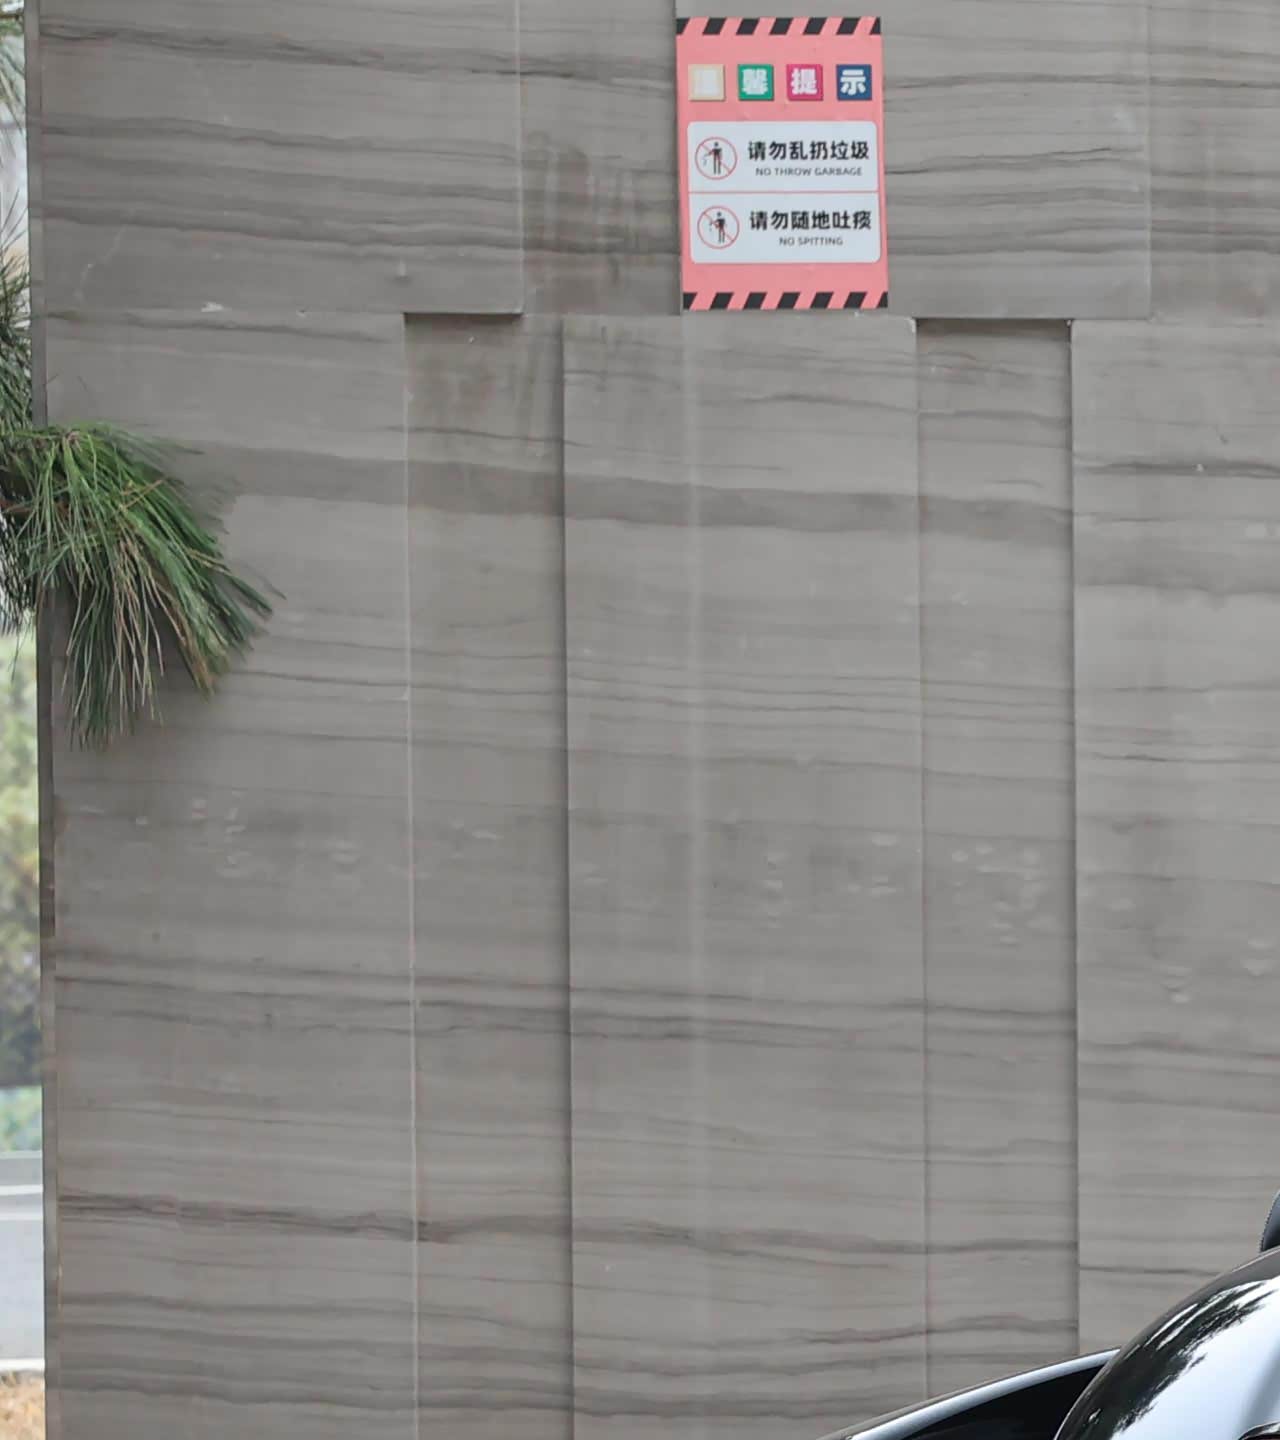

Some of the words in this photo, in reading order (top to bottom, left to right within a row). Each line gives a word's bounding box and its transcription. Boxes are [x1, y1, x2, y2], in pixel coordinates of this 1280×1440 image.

[748, 140, 869, 160] 请勿乱扔垃圾
[755, 167, 771, 176] NO
[774, 167, 811, 176] THROW
[815, 167, 862, 176] GARBAGE
[750, 210, 871, 230] 请勿随地吐痰
[779, 237, 795, 246] NO
[798, 237, 844, 246] SPITTING
